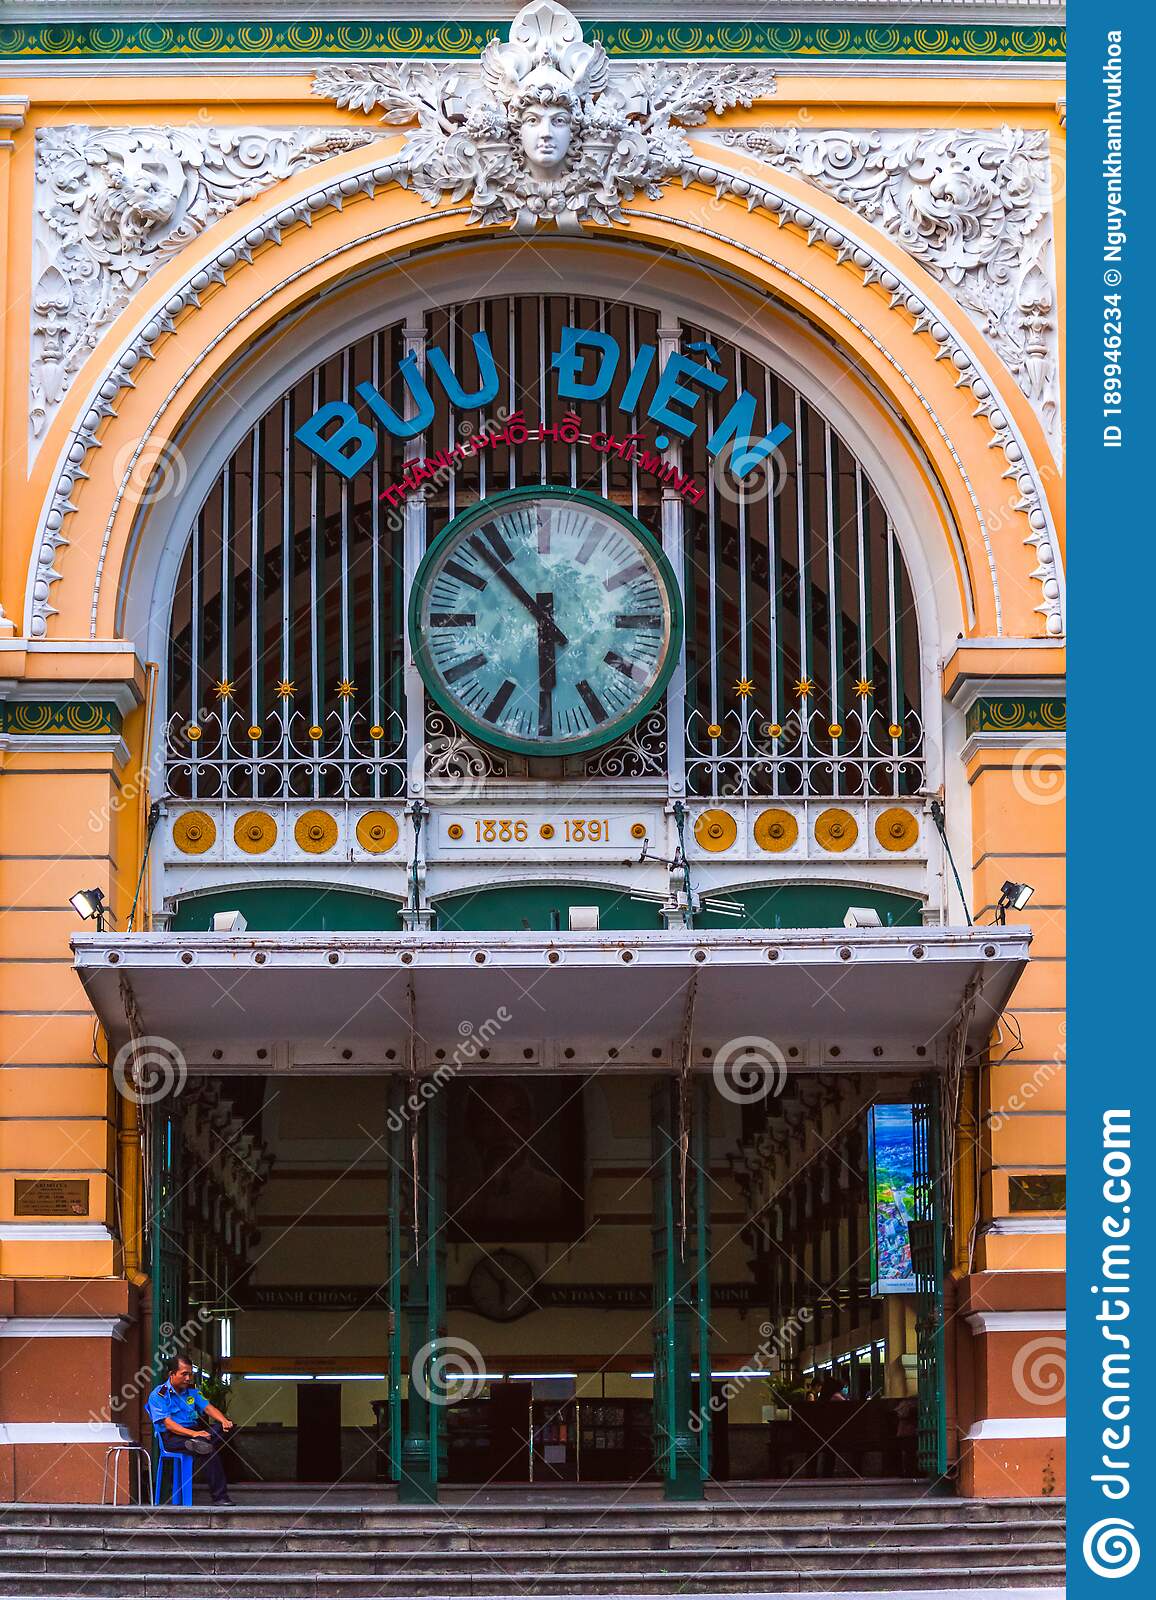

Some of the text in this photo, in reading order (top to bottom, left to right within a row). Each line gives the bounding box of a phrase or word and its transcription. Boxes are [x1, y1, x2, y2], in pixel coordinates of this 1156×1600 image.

[294, 326, 793, 479] BƯU ĐIỆN
[538, 411, 583, 444] HỒ
[590, 432, 649, 462] CHÍ
[637, 450, 706, 506] MINH
[475, 819, 610, 842] 1886 1891
